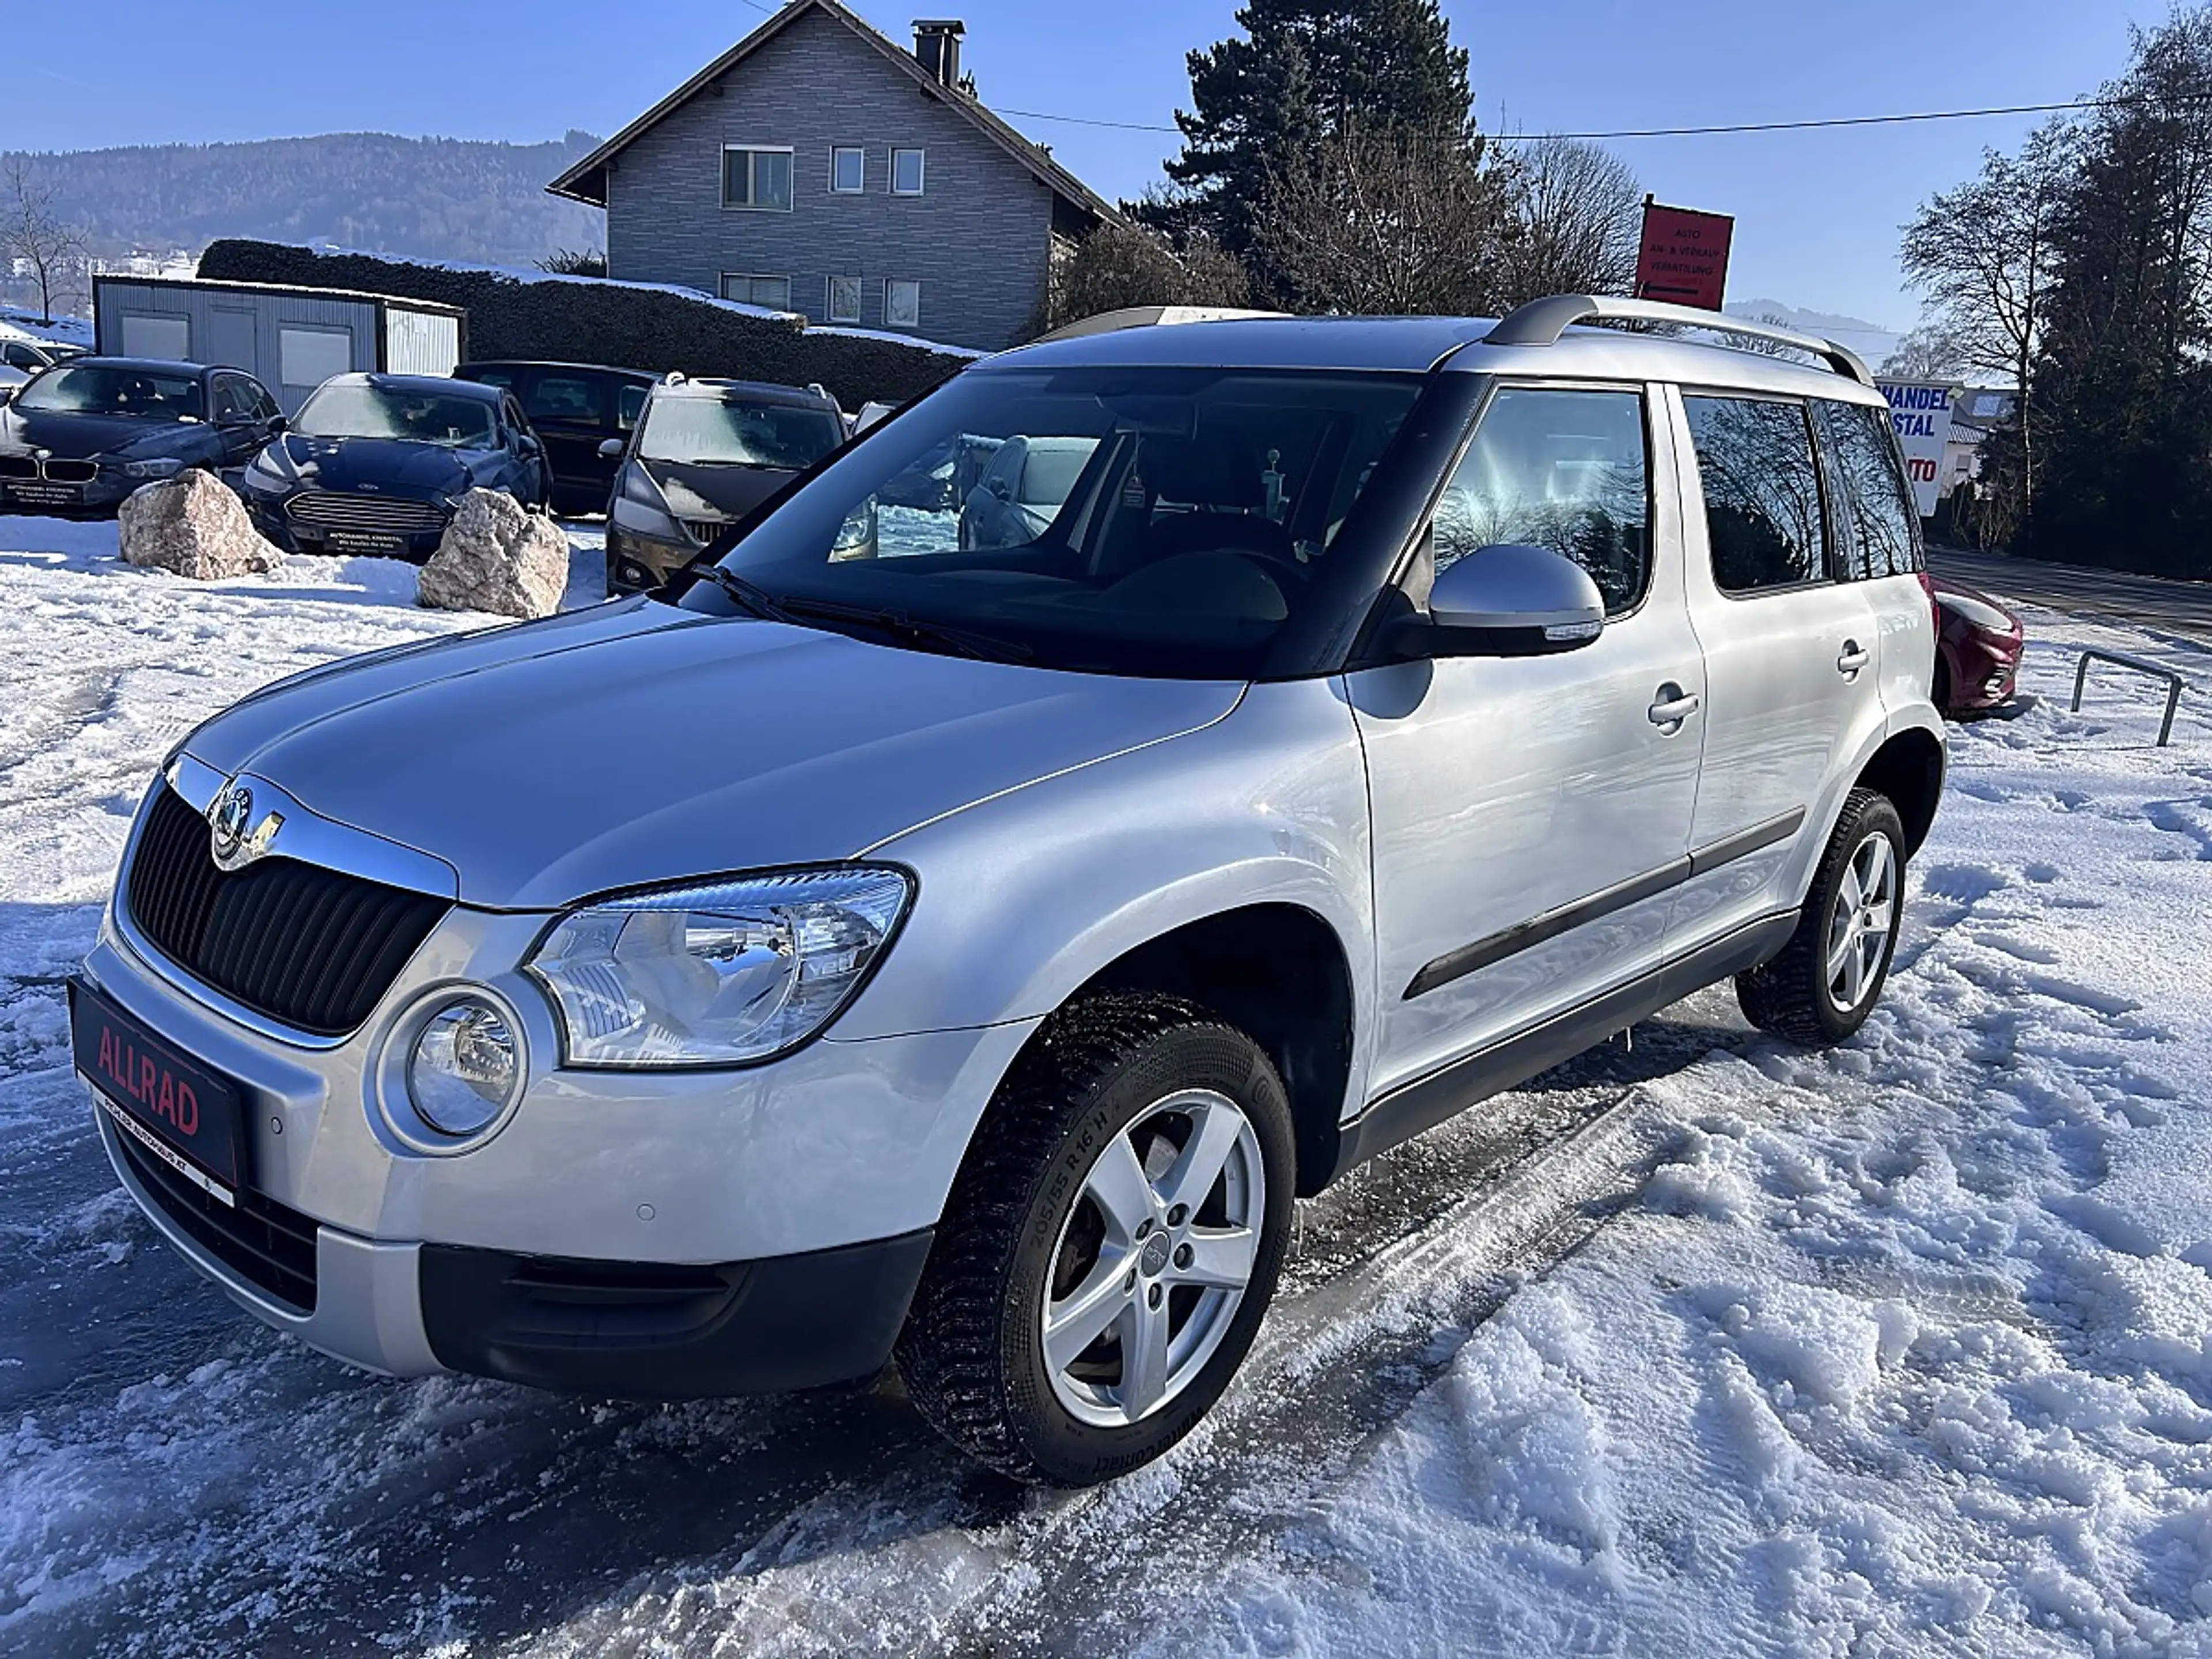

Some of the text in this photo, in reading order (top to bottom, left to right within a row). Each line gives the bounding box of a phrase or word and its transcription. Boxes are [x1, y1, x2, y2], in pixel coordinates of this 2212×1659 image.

[1877, 385, 1949, 411] HANDEL
[1908, 459, 1936, 482] TO
[98, 1025, 199, 1136] ALLRAD
[1030, 1111, 1108, 1249] 205/55 R 16 H
